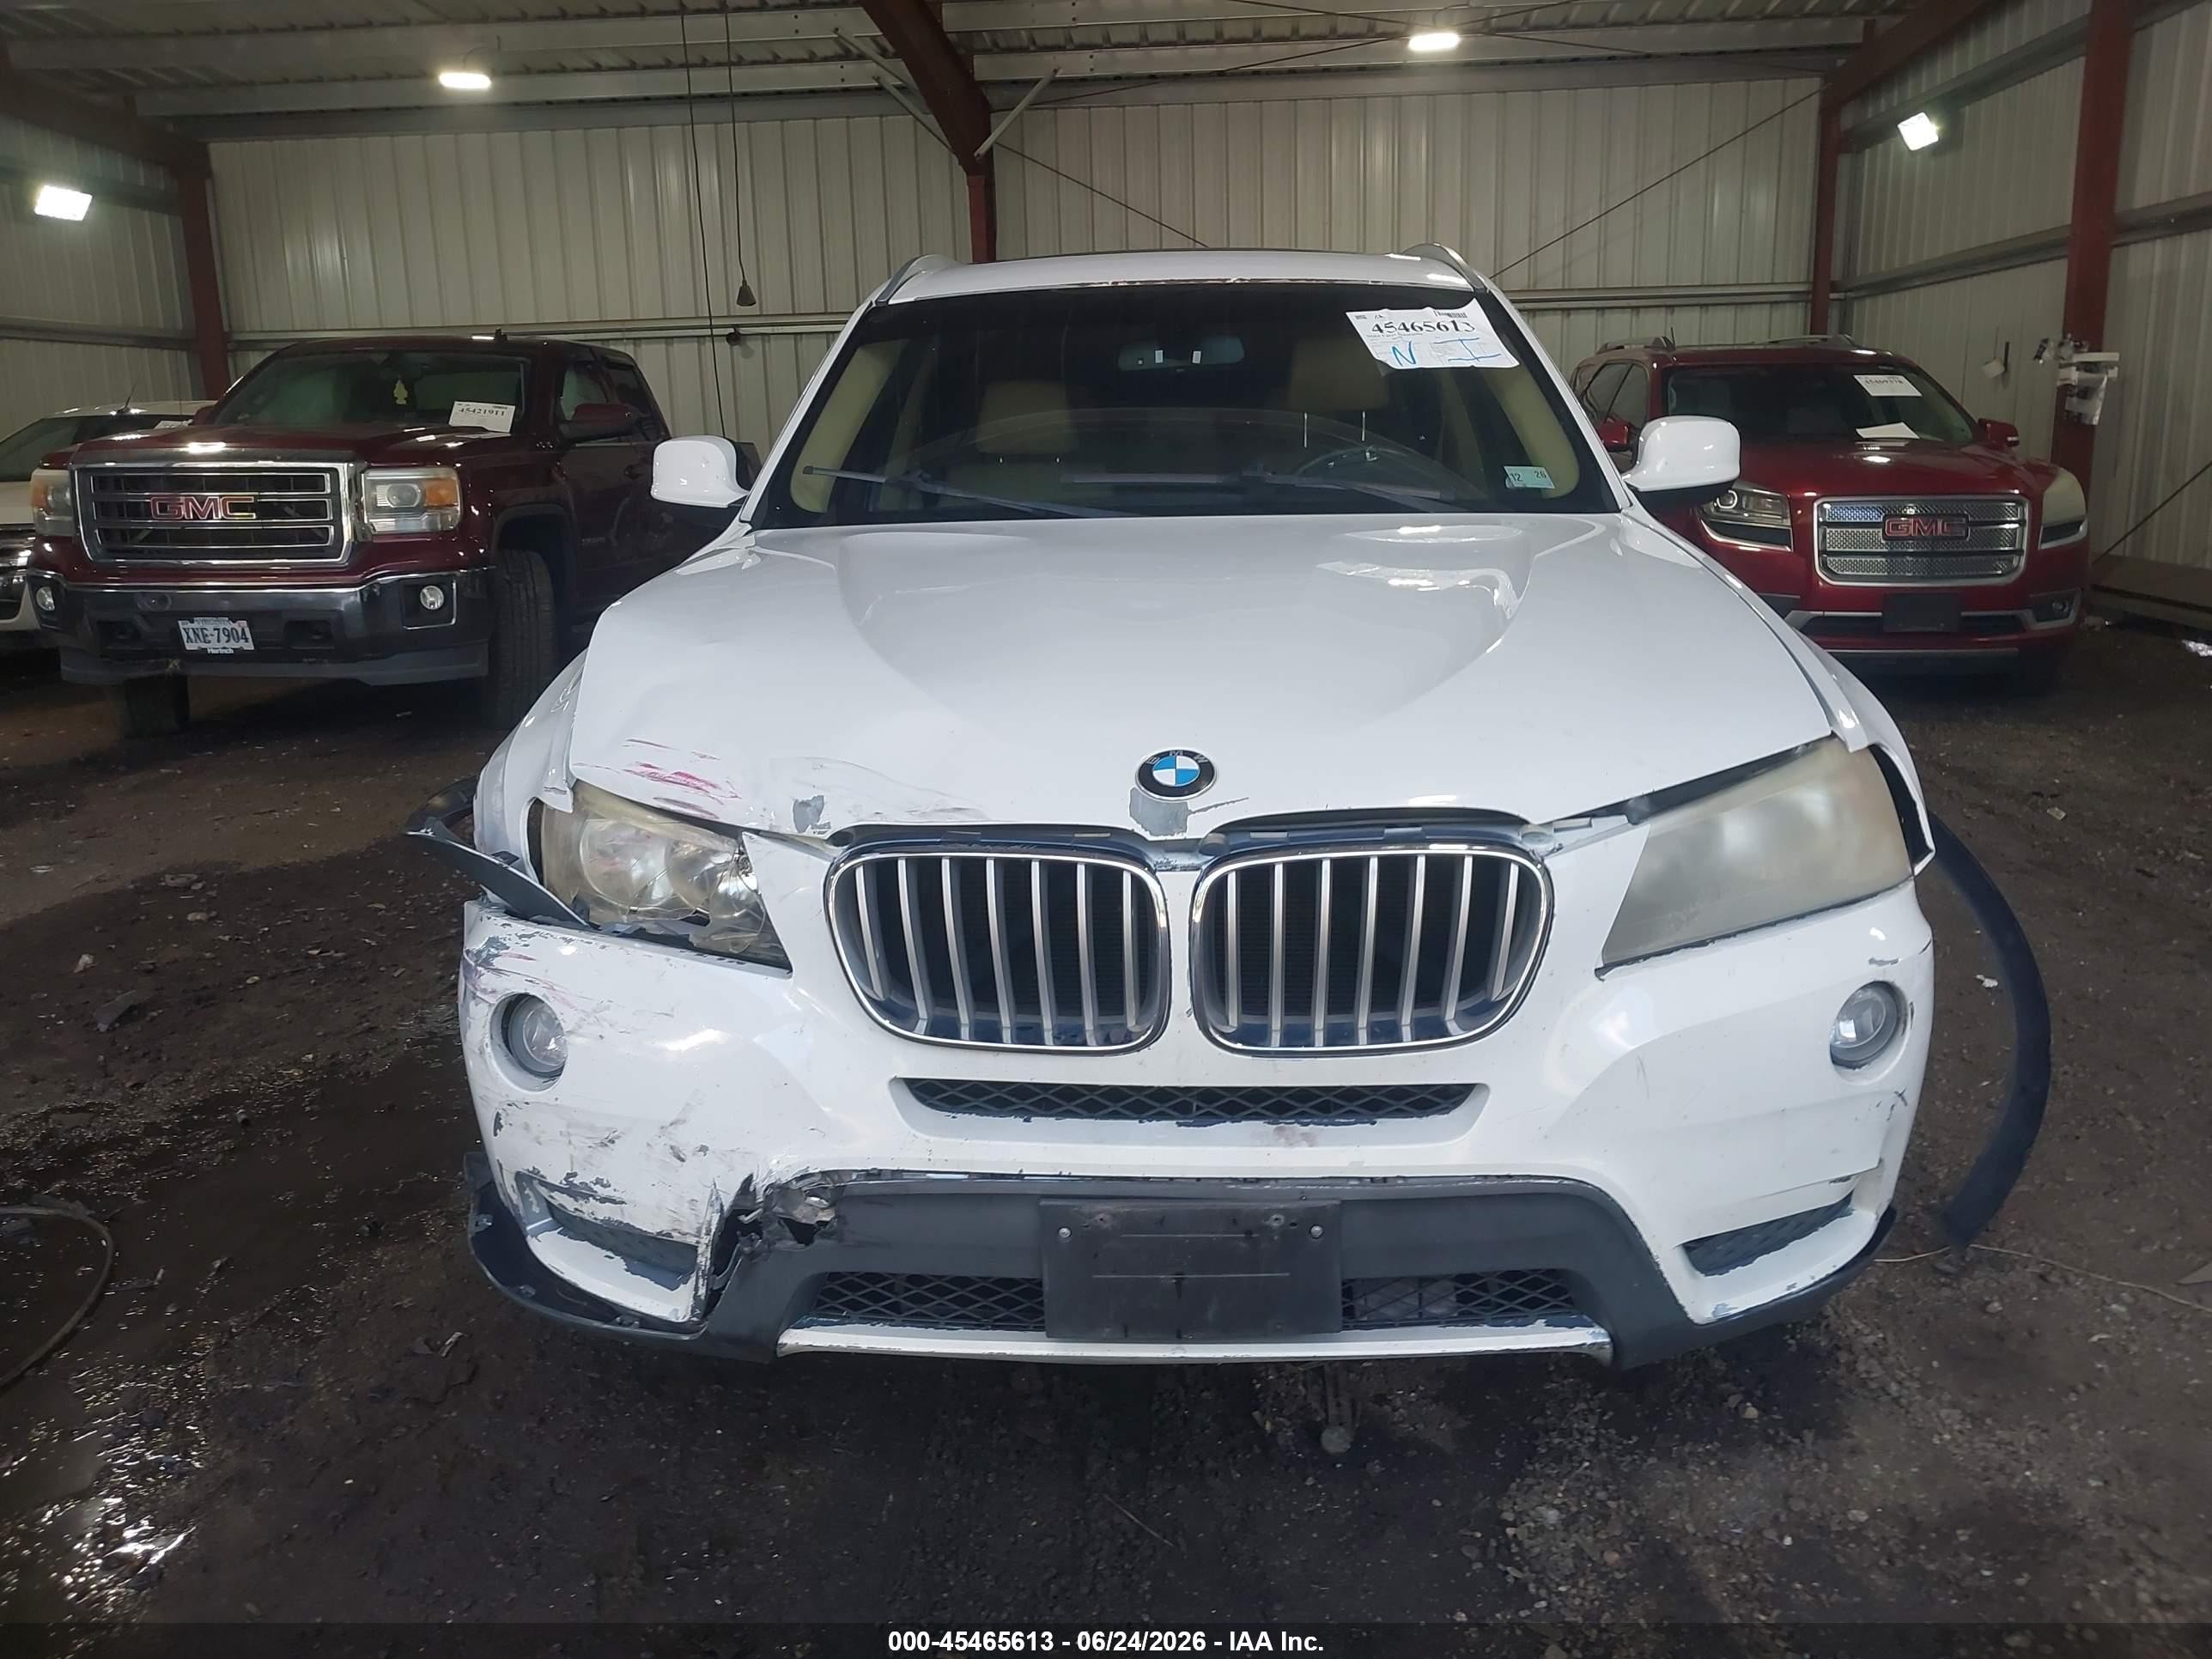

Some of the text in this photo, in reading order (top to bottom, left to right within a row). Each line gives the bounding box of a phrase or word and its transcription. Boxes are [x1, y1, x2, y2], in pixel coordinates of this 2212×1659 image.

[1371, 319, 1475, 333] 45465613
[1391, 341, 1417, 367] N
[150, 496, 256, 520] GMC
[1885, 518, 1966, 537] GMC
[182, 627, 250, 643] XNE-7904
[1146, 750, 1208, 764] BMW
